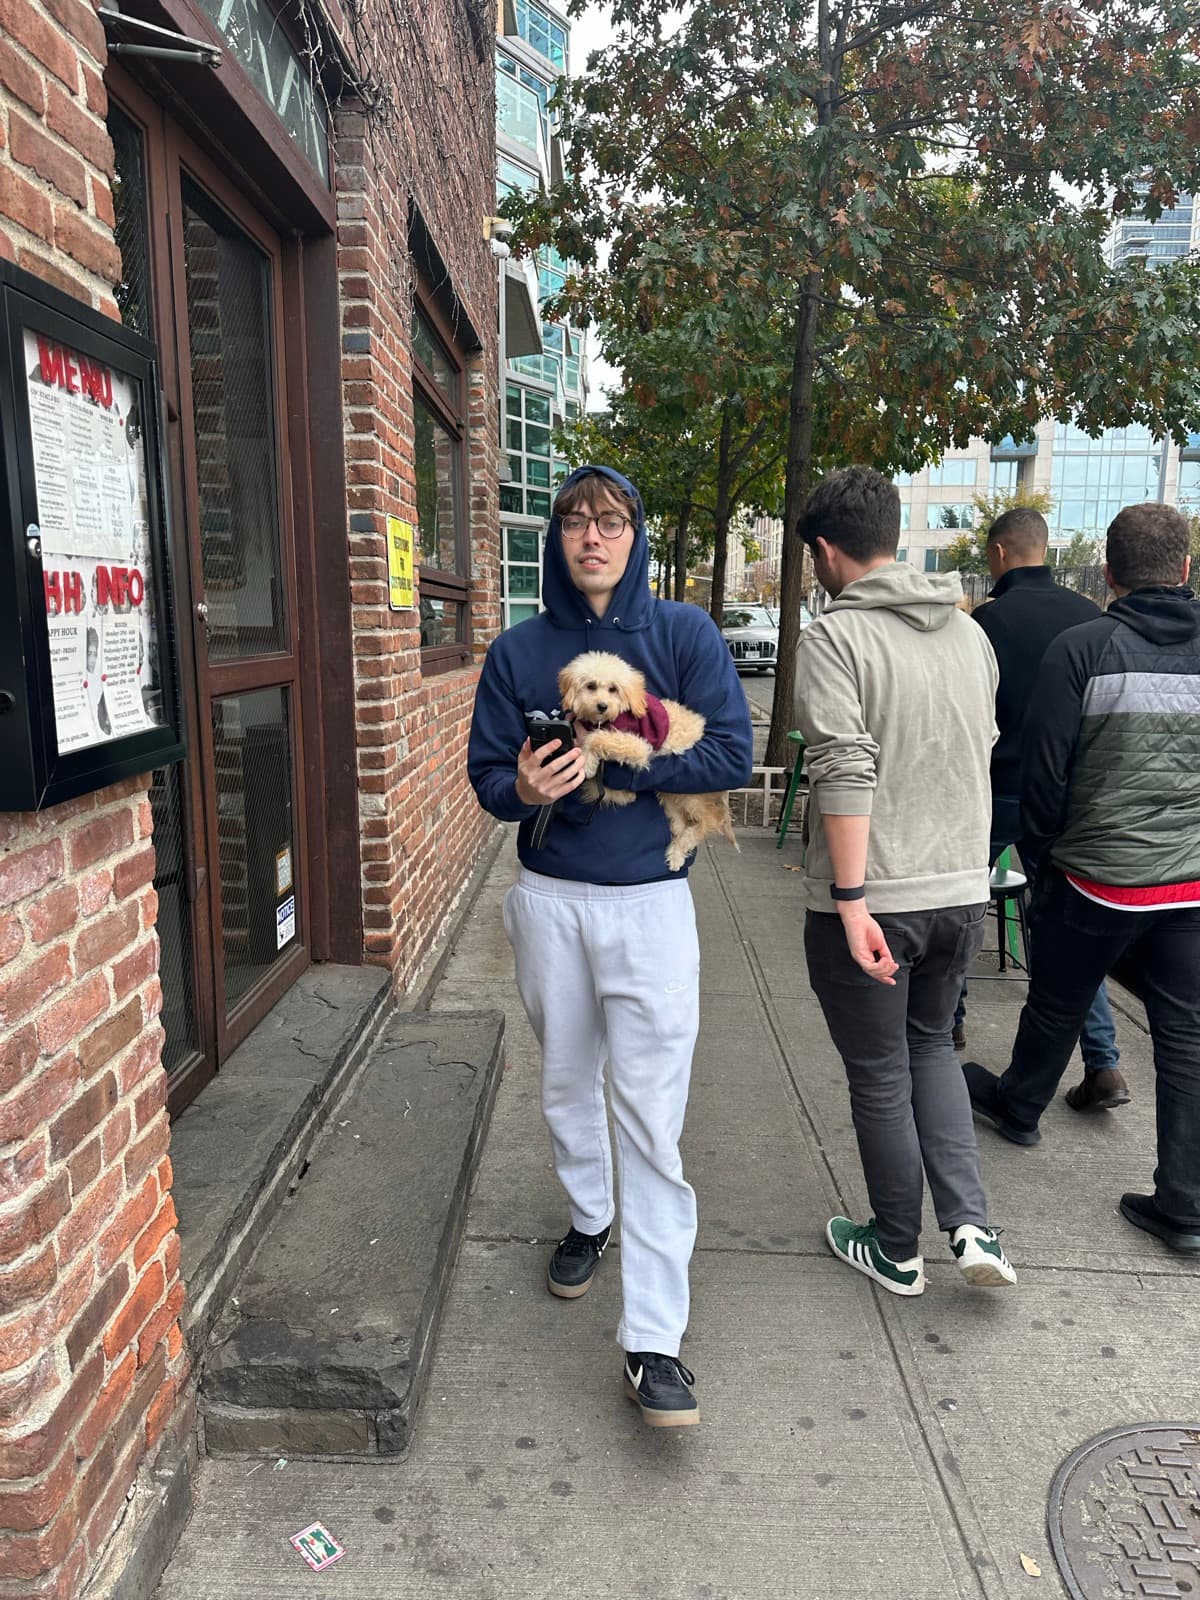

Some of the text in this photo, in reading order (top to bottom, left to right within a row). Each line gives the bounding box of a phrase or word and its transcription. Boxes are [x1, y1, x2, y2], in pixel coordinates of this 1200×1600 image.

[36, 336, 113, 409] MENU
[43, 570, 82, 615] HH
[61, 627, 77, 636] HOUR
[278, 901, 294, 923] NOTICE
